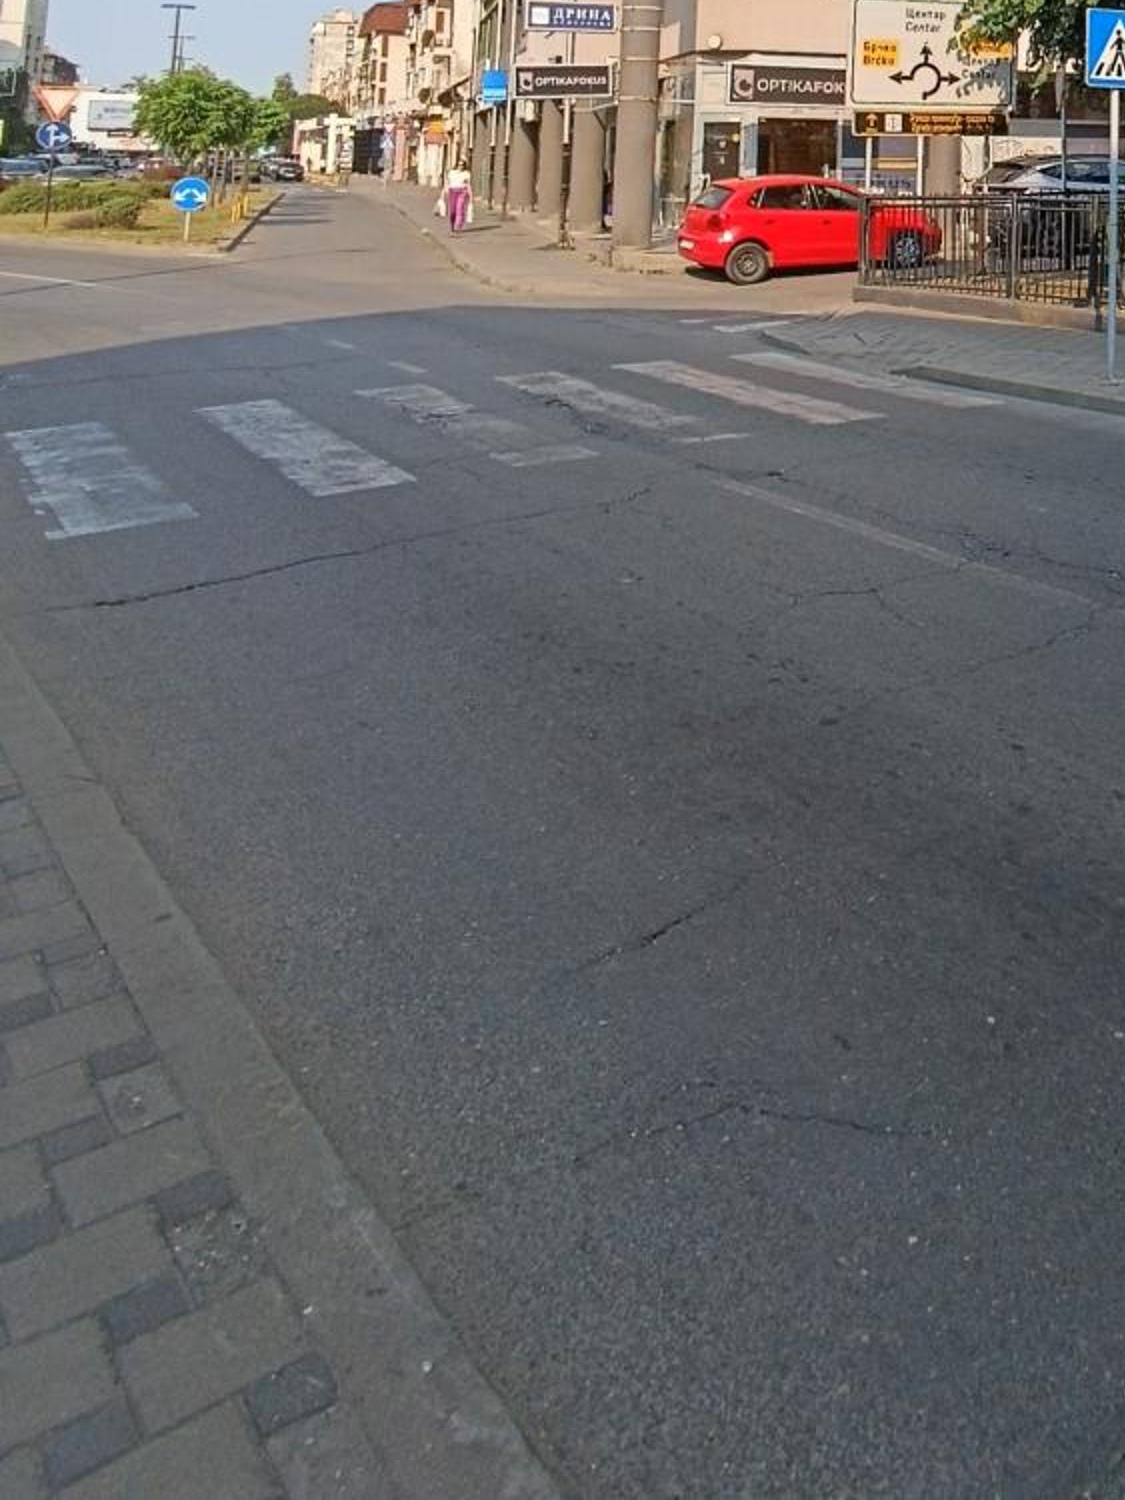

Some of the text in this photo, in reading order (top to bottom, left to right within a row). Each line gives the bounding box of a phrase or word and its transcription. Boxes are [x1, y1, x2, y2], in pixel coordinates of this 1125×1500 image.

[553, 7, 611, 22] ДРИНА
[905, 8, 946, 20] Центар
[905, 22, 941, 32] Centar
[863, 41, 897, 52] Брчко
[535, 76, 607, 87] OPTIKAFOKUS
[757, 78, 845, 93] OPTIKAFOK
